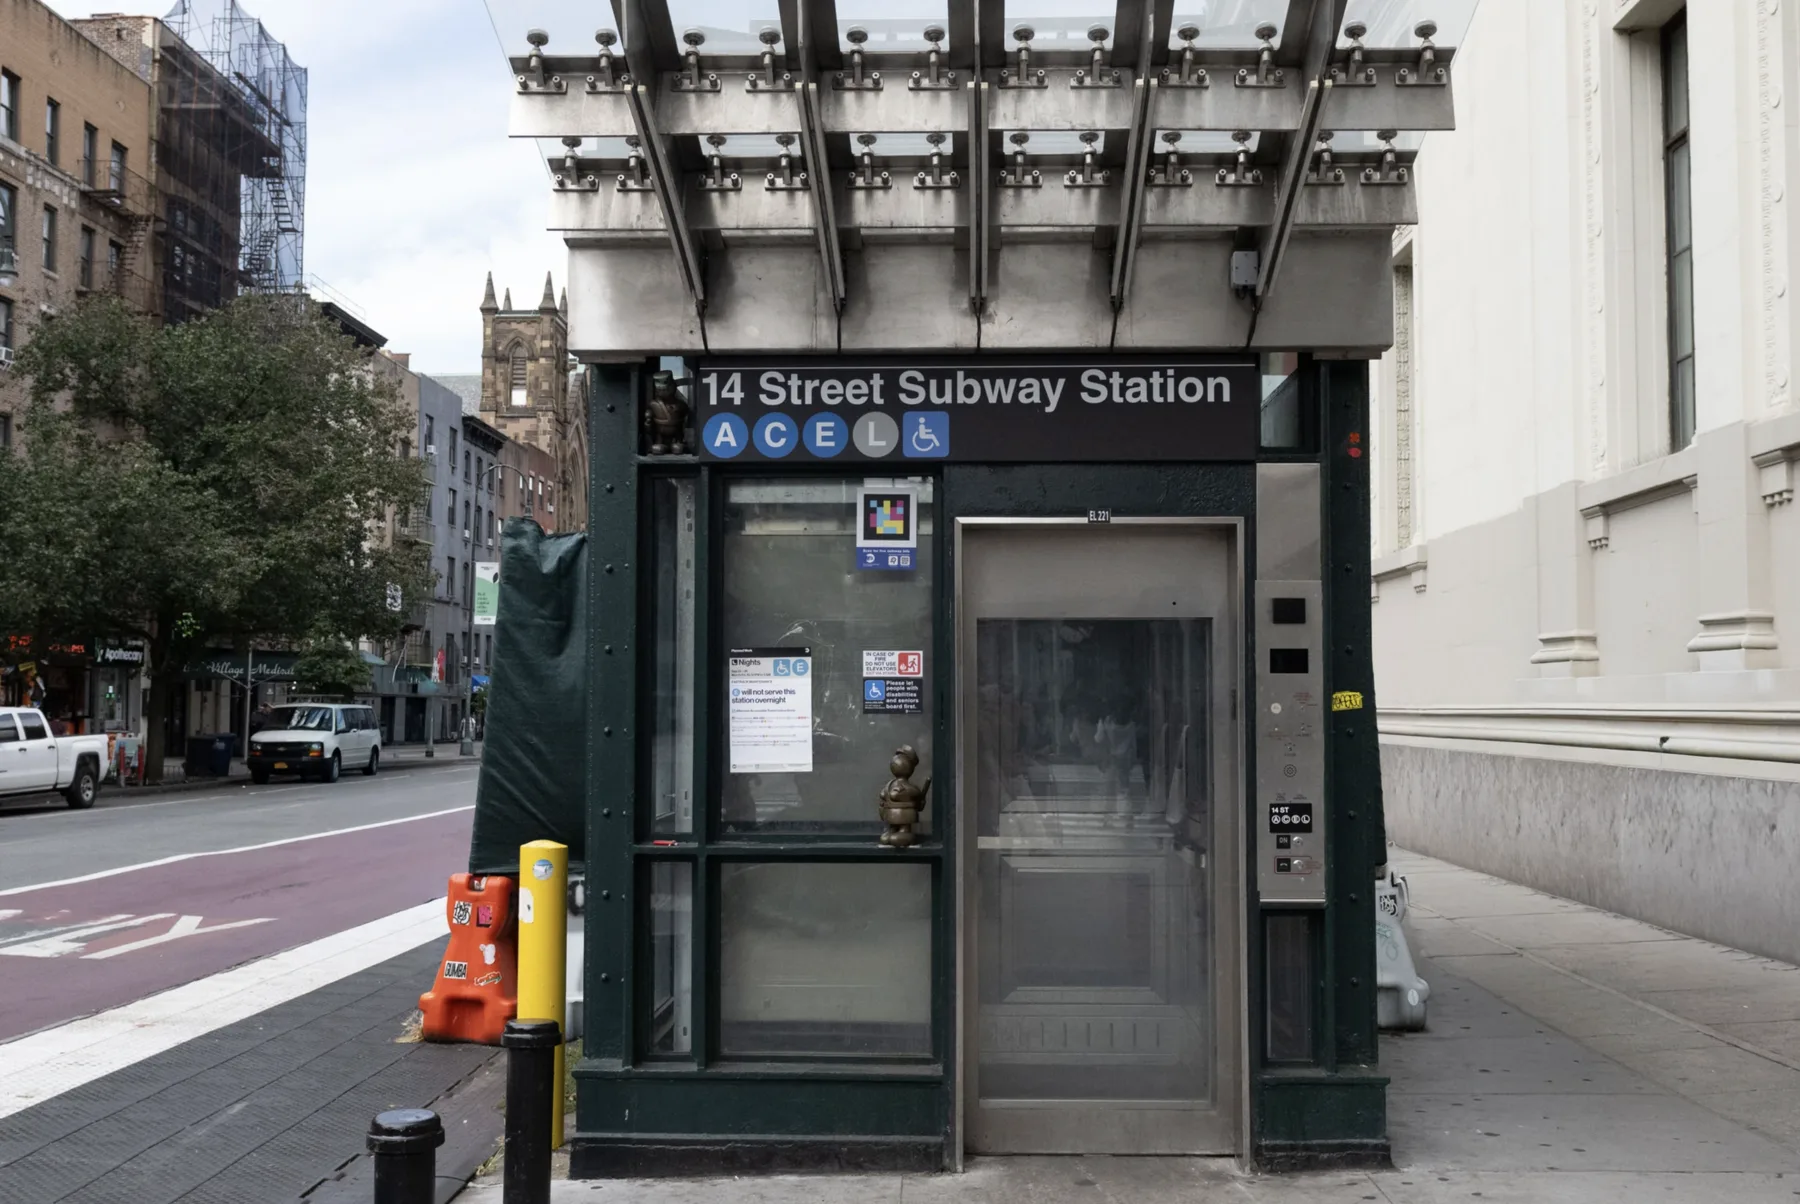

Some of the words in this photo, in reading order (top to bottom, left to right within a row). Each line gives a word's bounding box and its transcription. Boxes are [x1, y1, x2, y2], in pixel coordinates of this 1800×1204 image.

[702, 372, 745, 405] 14
[759, 371, 884, 406] Street
[898, 370, 1066, 412] Subway
[1080, 368, 1230, 404] Station
[714, 422, 737, 447] A
[764, 422, 786, 448] C
[816, 422, 836, 447] E
[868, 421, 886, 446] L
[1098, 510, 1108, 521] 221
[105, 648, 143, 663] Apothecary
[739, 659, 761, 667] Nights
[207, 662, 244, 678] Village
[250, 663, 295, 675] Medical
[796, 663, 804, 672] E
